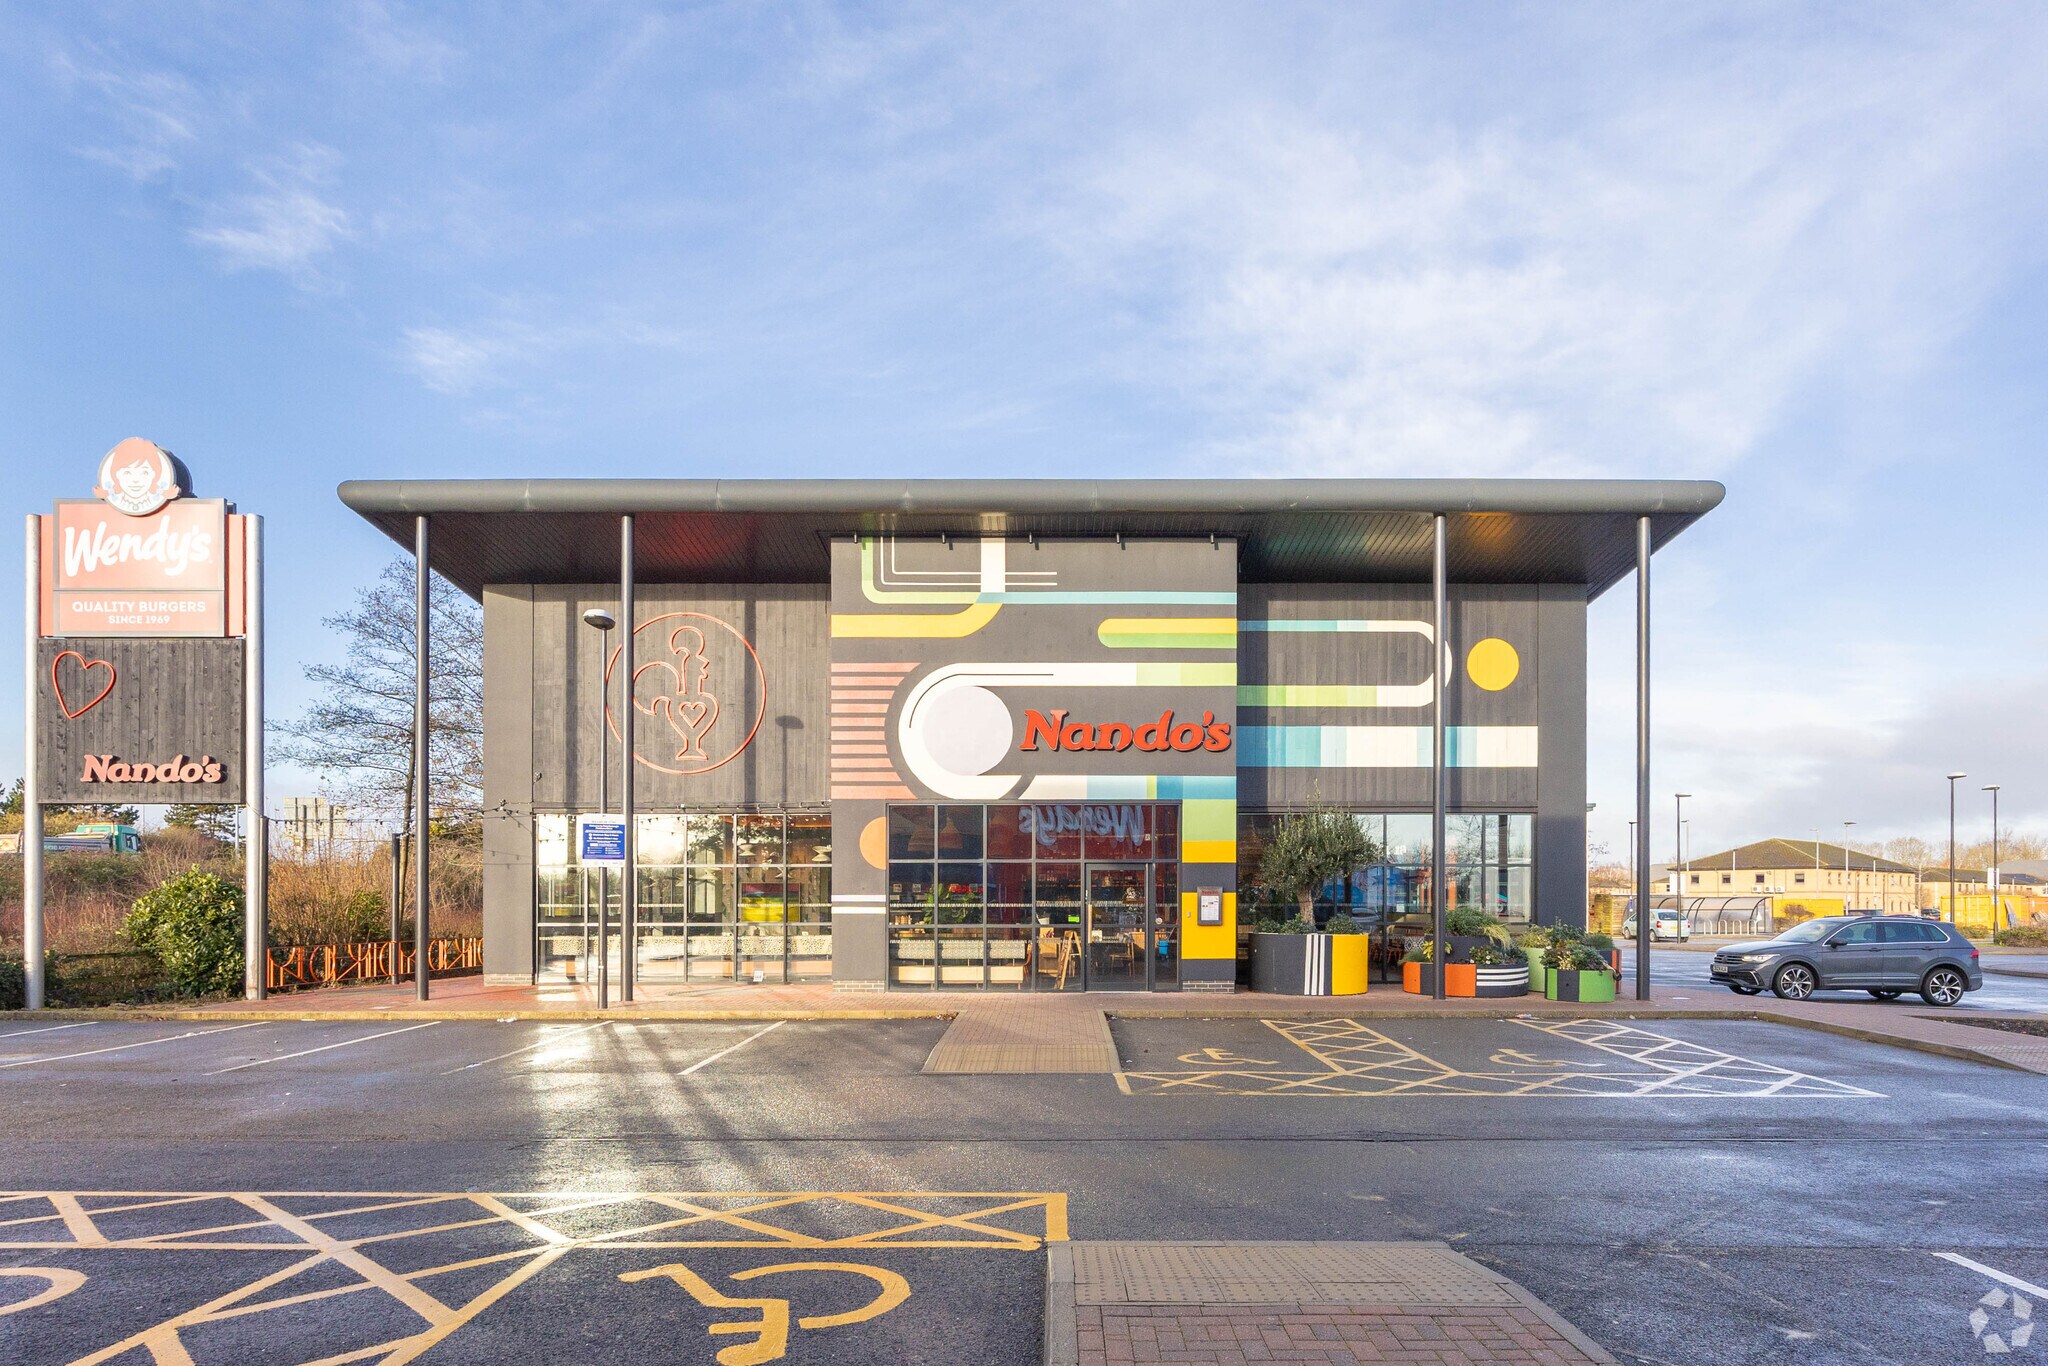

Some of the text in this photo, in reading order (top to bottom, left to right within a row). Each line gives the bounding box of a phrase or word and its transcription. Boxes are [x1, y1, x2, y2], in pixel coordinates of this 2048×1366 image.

[64, 515, 211, 577] Wendy's
[72, 601, 206, 613] QUALITY BURGERS
[108, 615, 170, 625] SINCE 1969
[1019, 709, 1231, 752] Nando's
[80, 754, 222, 783] Nando's
